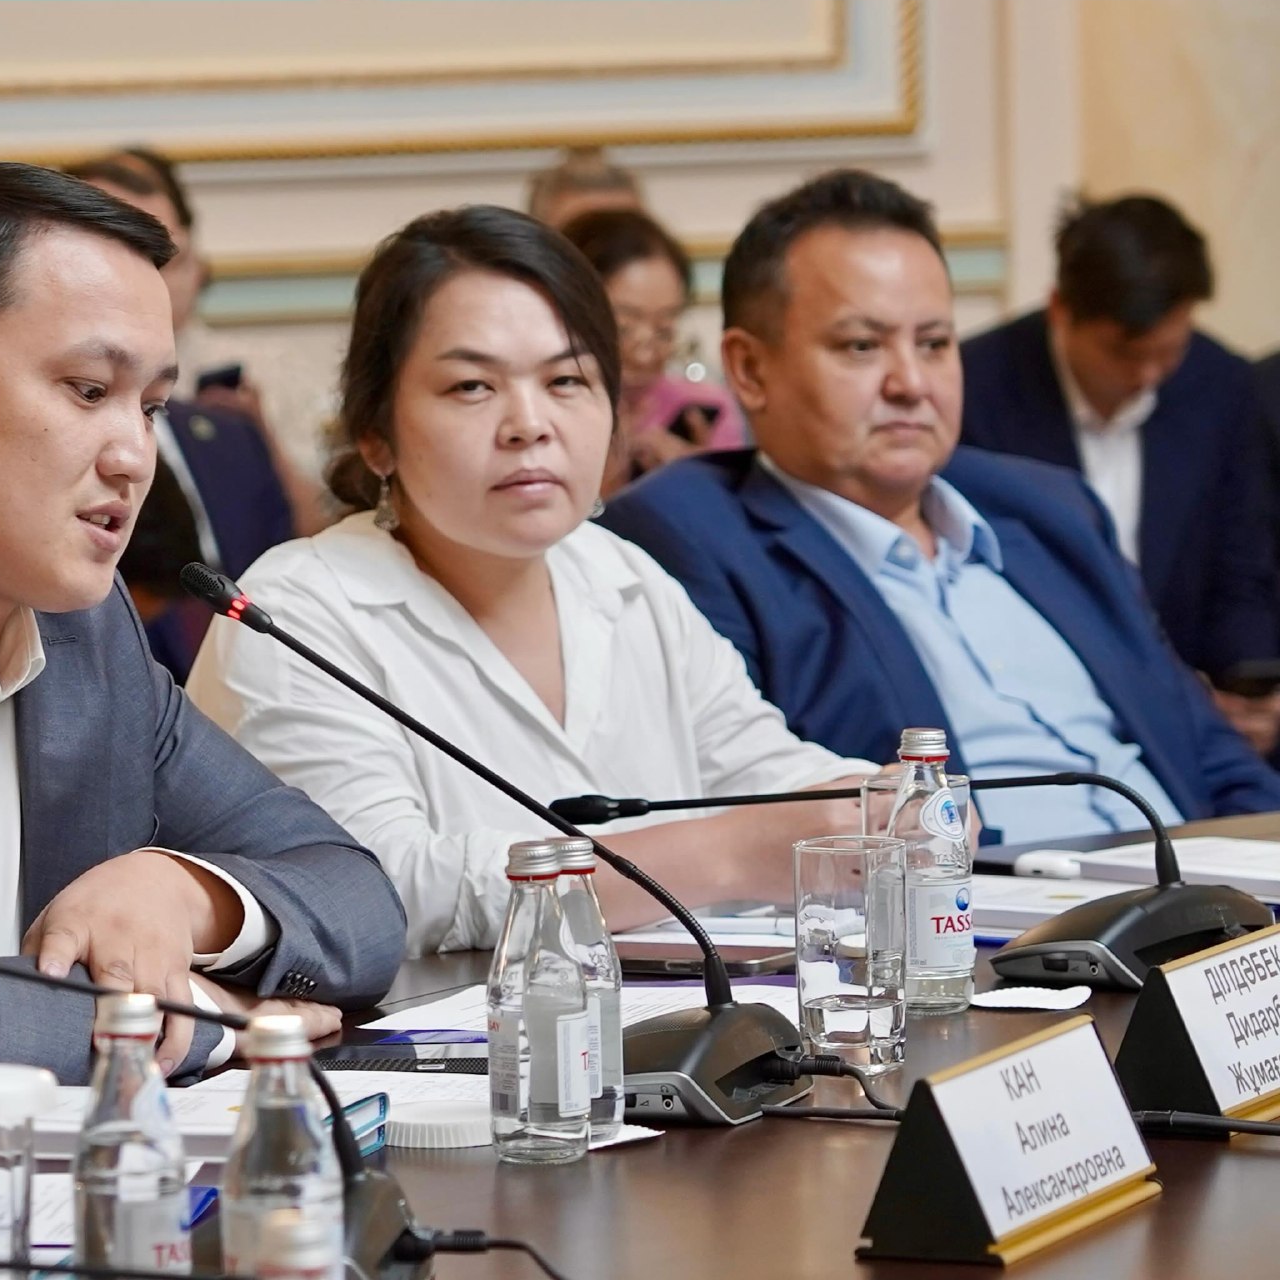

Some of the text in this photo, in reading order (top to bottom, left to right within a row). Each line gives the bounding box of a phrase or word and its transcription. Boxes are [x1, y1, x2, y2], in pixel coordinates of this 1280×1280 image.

[930, 914, 972, 934] TASS
[1000, 1058, 1042, 1101] КАН
[1228, 1054, 1280, 1096] Жұмағ
[1015, 1111, 1071, 1155] Алина
[1001, 1145, 1126, 1220] Александровна
